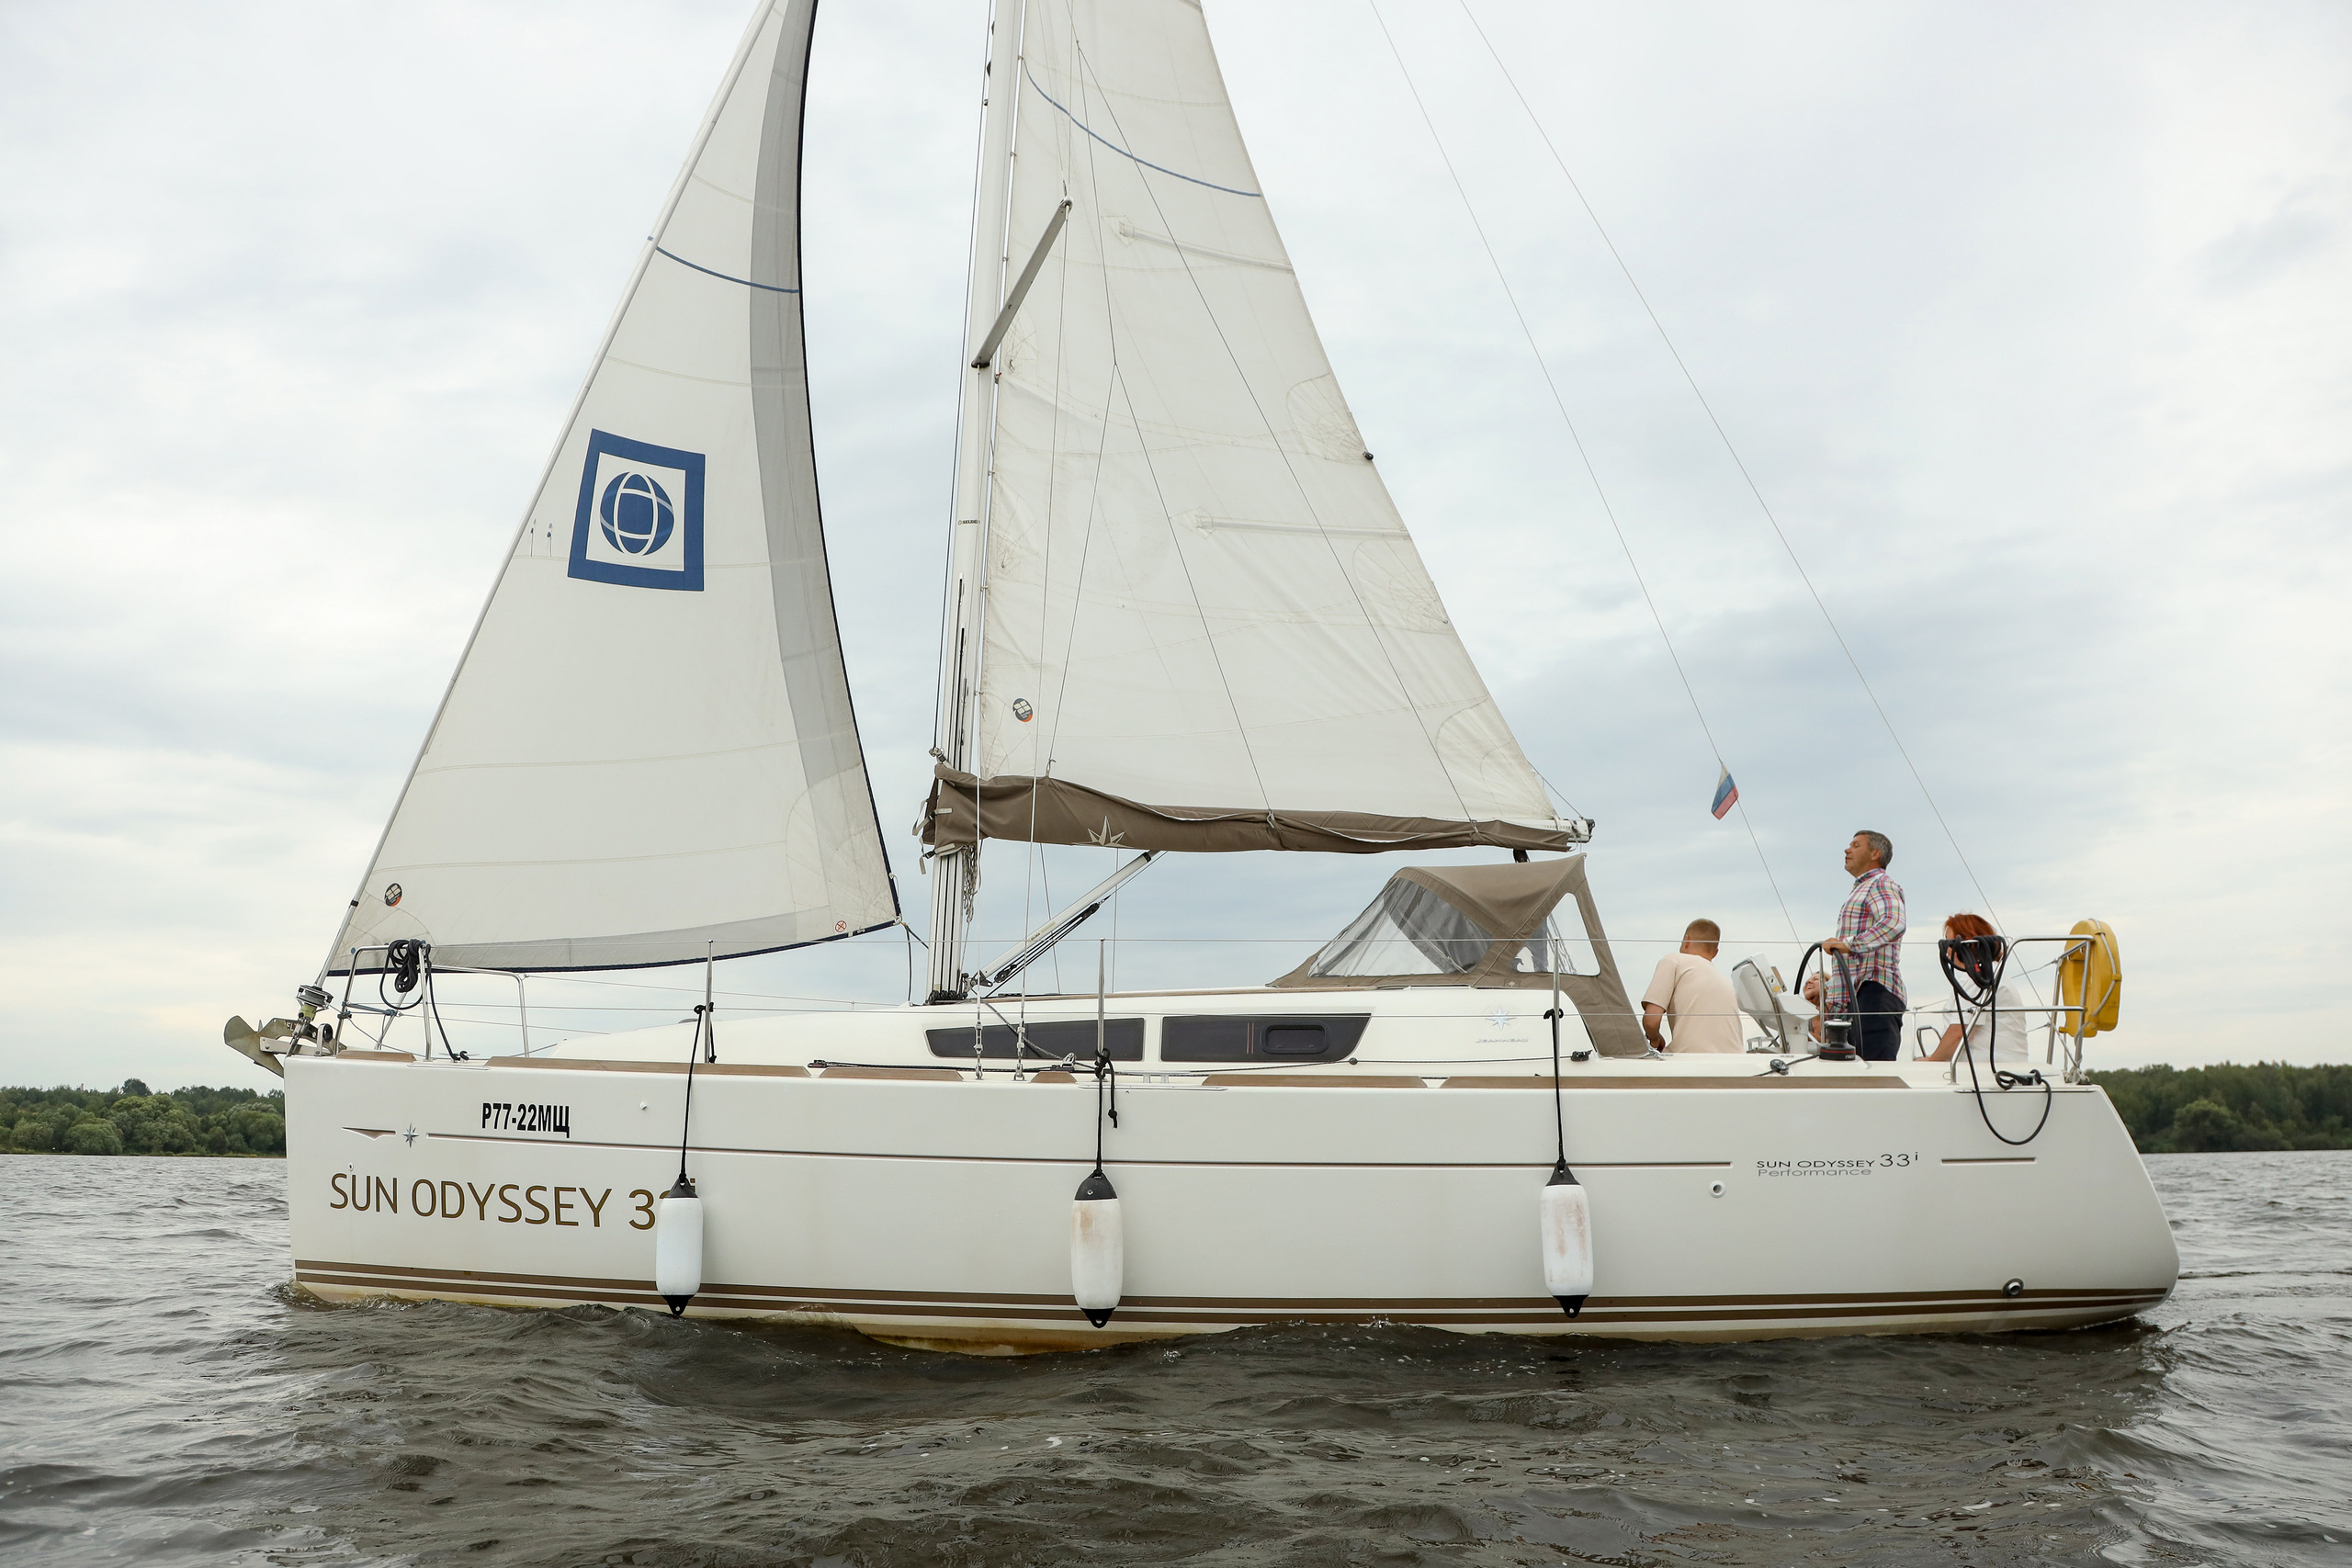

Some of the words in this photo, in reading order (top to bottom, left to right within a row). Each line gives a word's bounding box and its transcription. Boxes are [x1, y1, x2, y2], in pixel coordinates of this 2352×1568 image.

[481, 1102, 570, 1139] Р77-22МЩ
[1757, 1160, 1791, 1168] SUN
[1797, 1160, 1875, 1168] ODYSSEY
[1758, 1168, 1871, 1178] Performance
[330, 1172, 398, 1214] SUN
[411, 1178, 613, 1228] ODYSSEY
